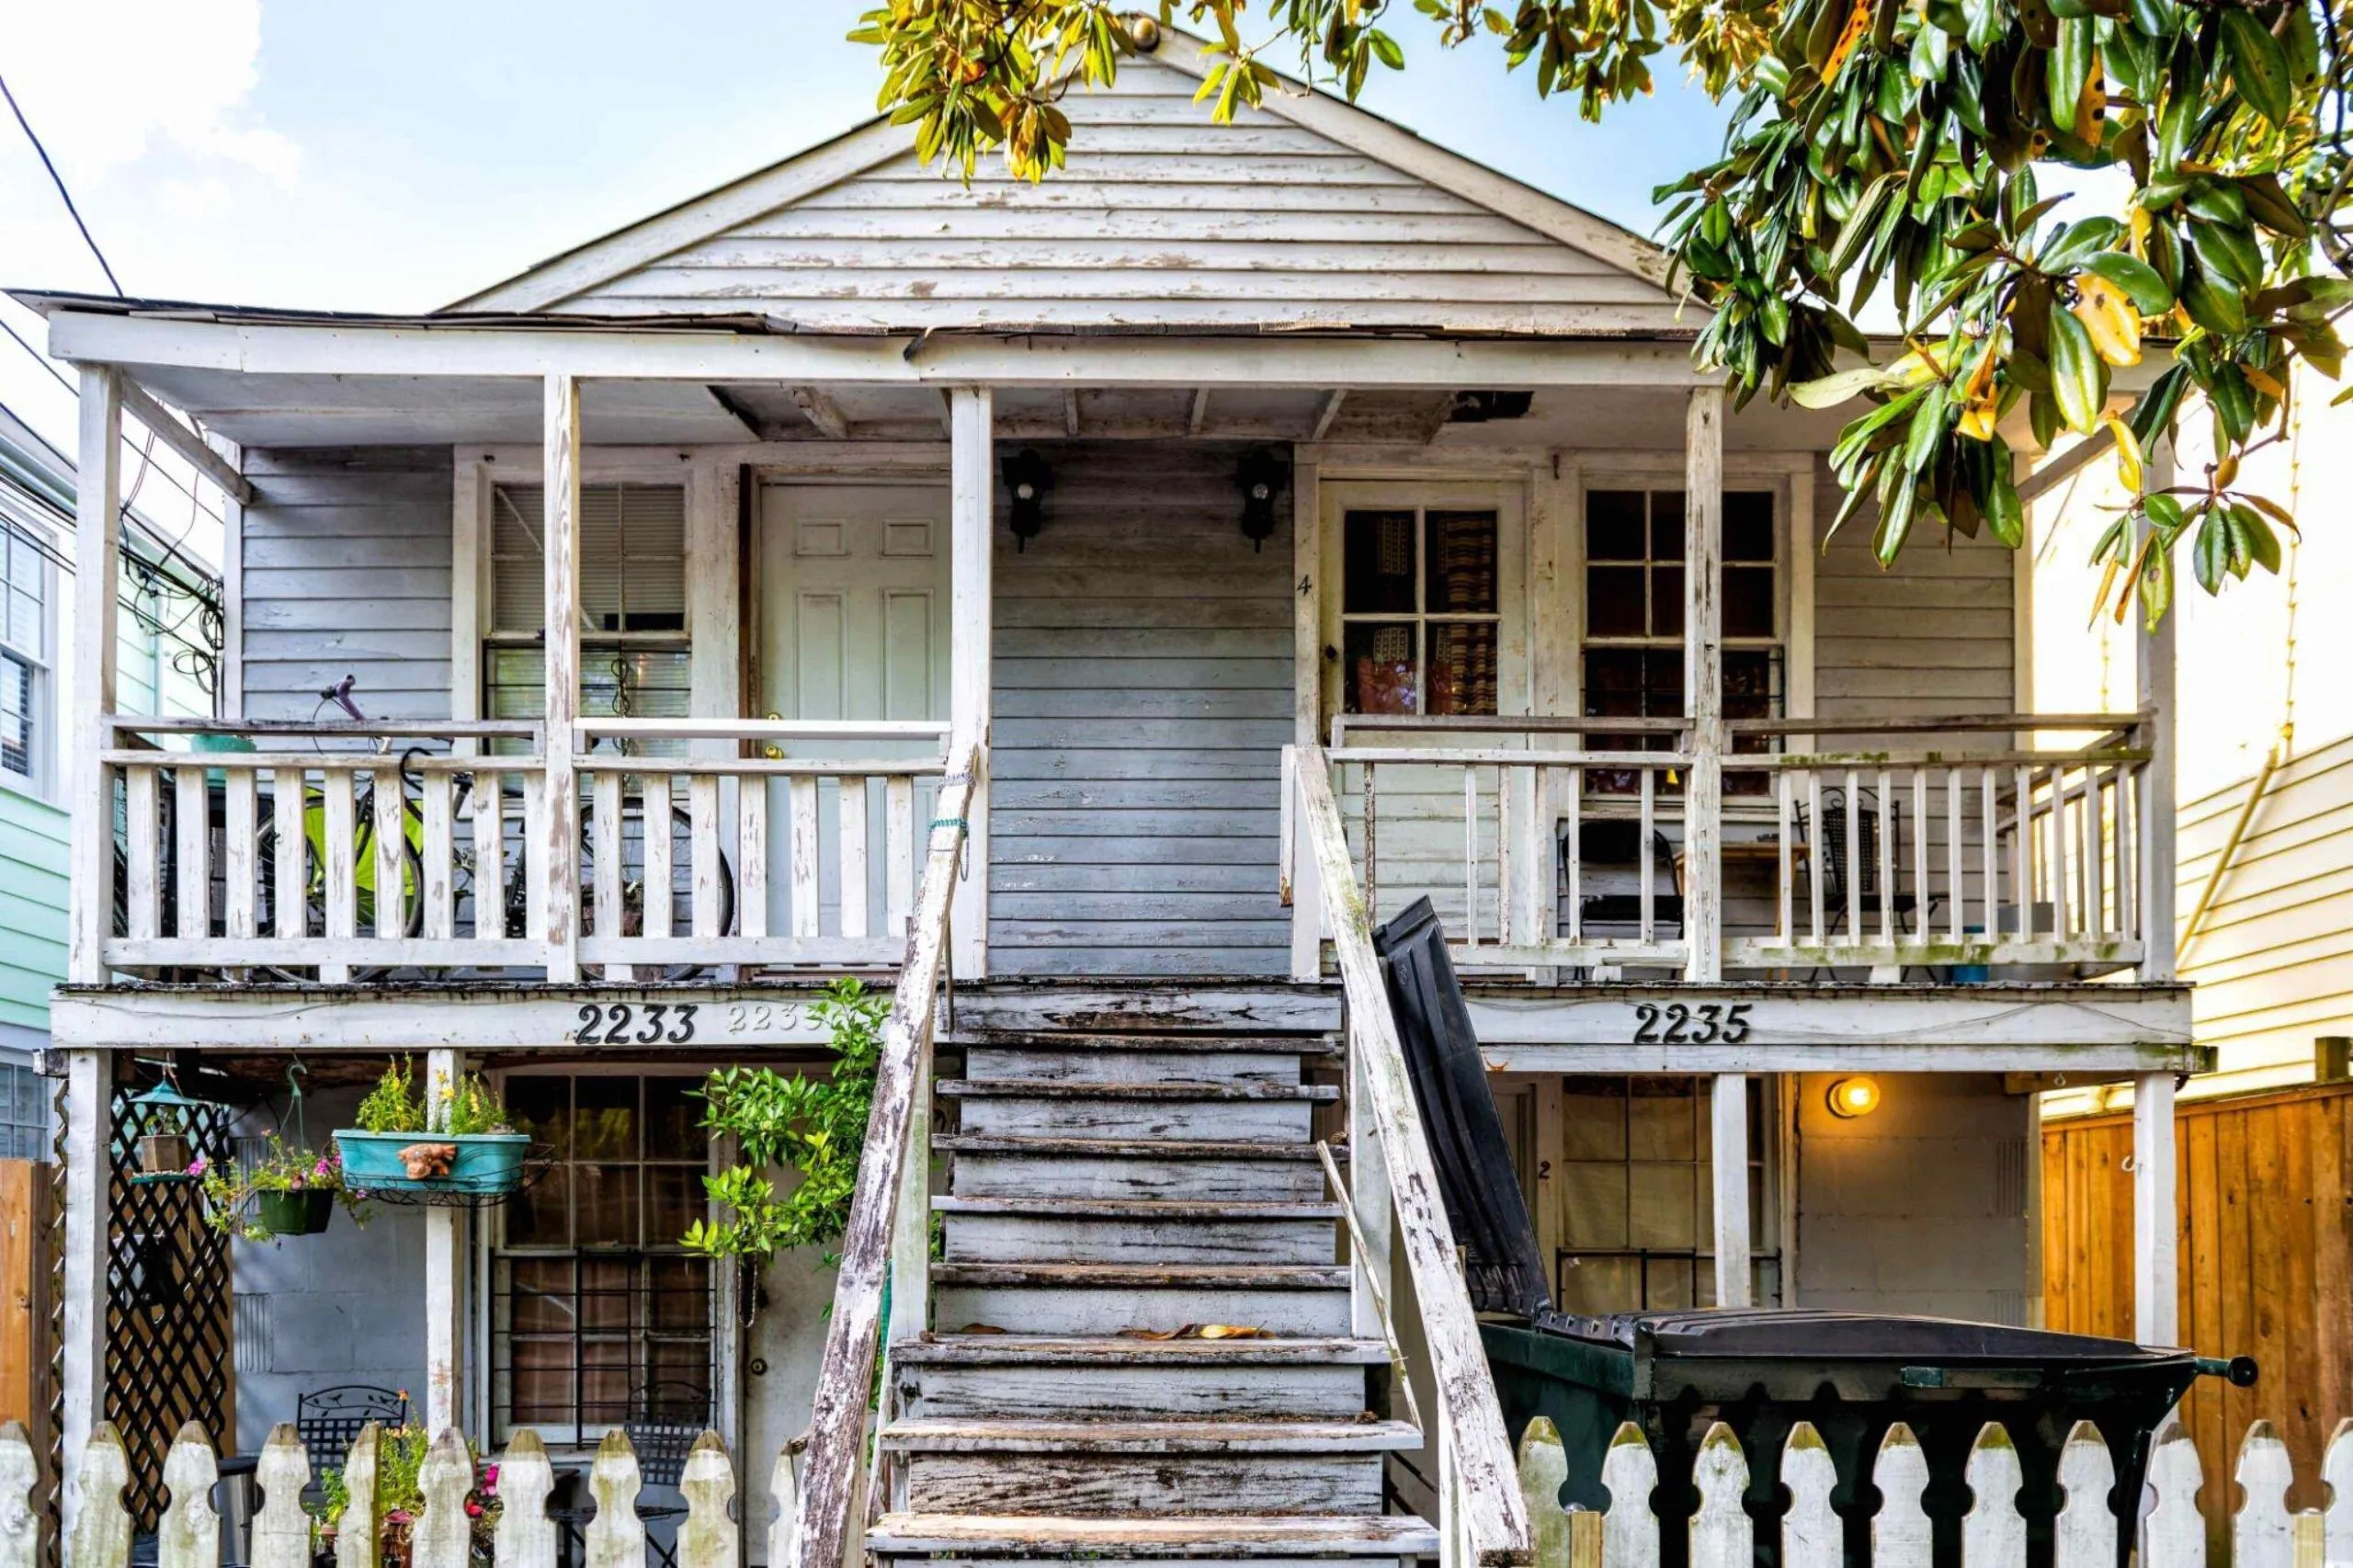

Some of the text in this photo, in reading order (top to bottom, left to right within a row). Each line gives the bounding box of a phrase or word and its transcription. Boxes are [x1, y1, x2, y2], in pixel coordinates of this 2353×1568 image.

[1297, 573, 1313, 597] 4
[575, 1003, 699, 1045] 2233
[1633, 1003, 1753, 1044] 2235
[1538, 1160, 1552, 1180] 2
